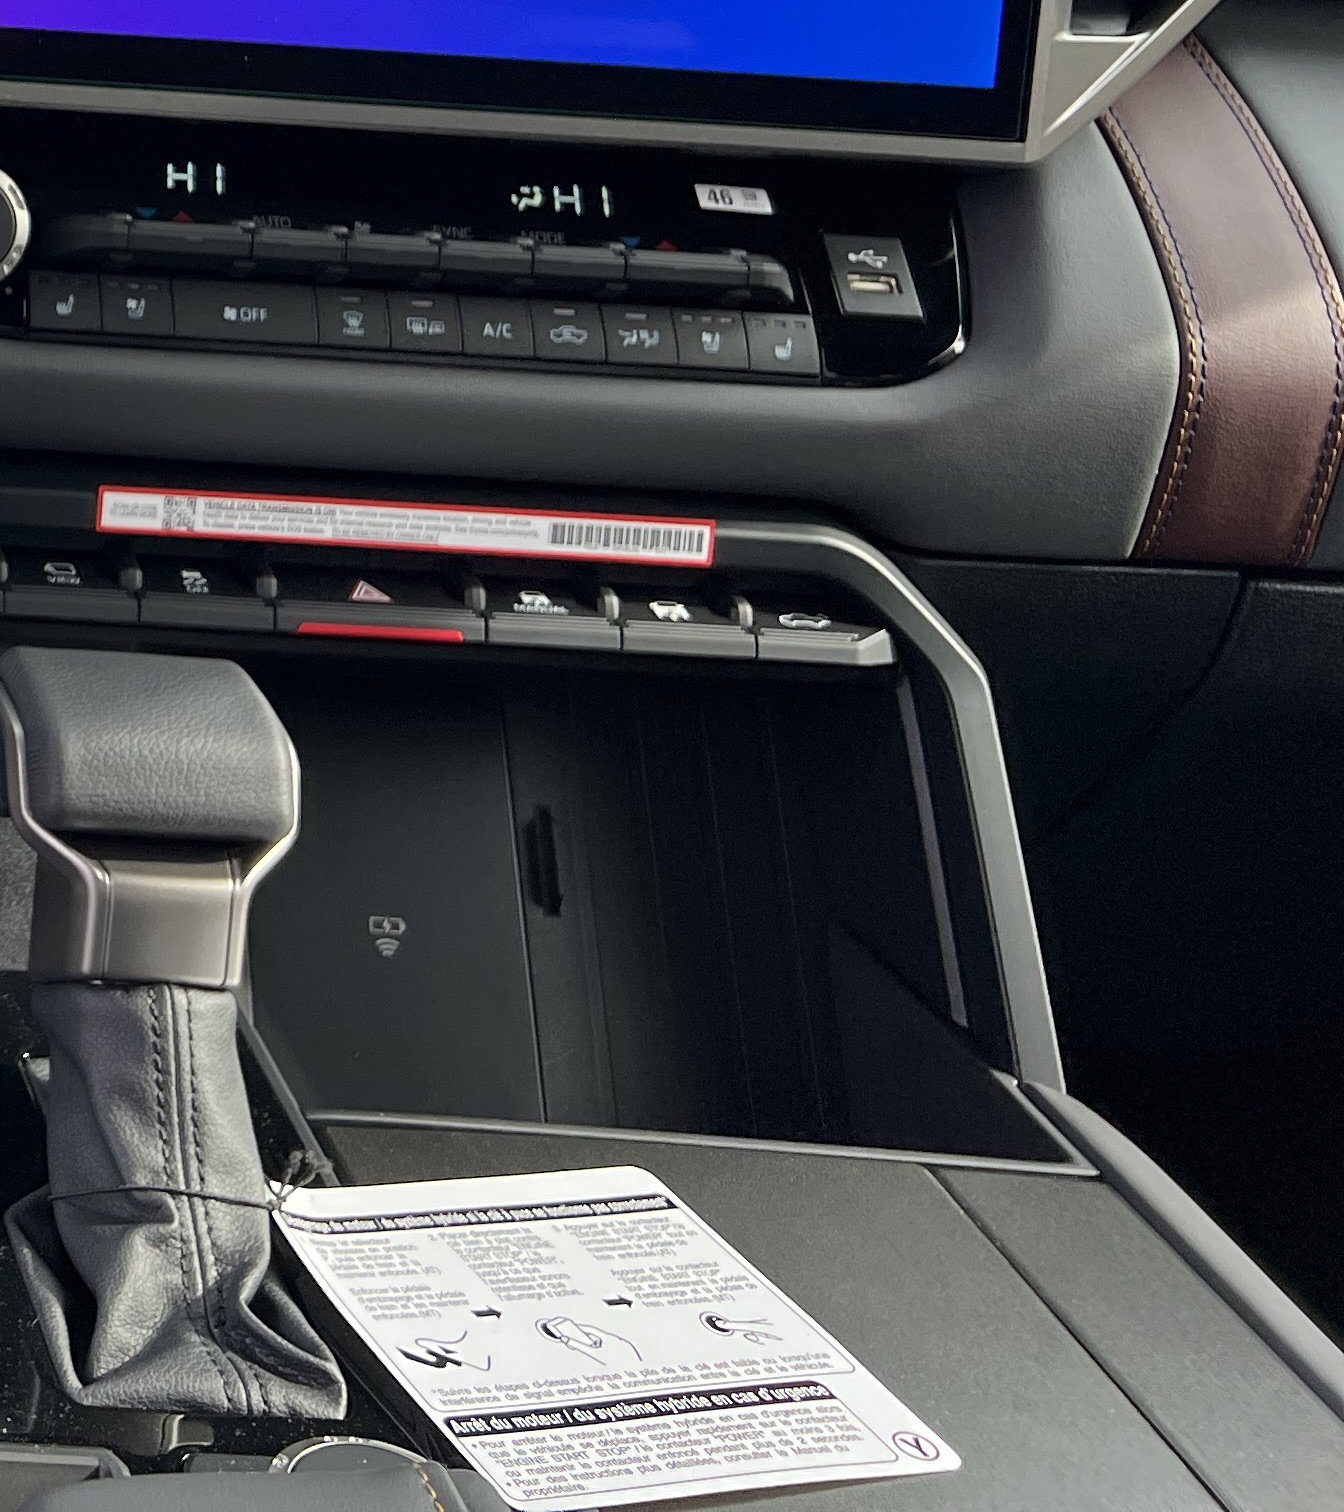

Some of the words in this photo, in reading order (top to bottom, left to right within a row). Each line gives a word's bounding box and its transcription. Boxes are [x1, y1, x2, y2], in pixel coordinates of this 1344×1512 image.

[240, 306, 268, 322] OFF
[482, 322, 513, 340] A/C
[449, 1415, 492, 1434] Arrêt
[490, 1413, 513, 1430] du
[511, 1410, 564, 1428] moteur
[573, 1407, 597, 1422] du
[595, 1399, 657, 1422] système
[653, 1393, 712, 1414] hybride
[711, 1392, 732, 1406] en
[732, 1390, 760, 1404] cas
[758, 1384, 831, 1403] d'urgence
[478, 1437, 506, 1450] Pour
[898, 1437, 931, 1458] Y
[551, 1449, 591, 1462] START
[512, 1476, 542, 1488] Pour
